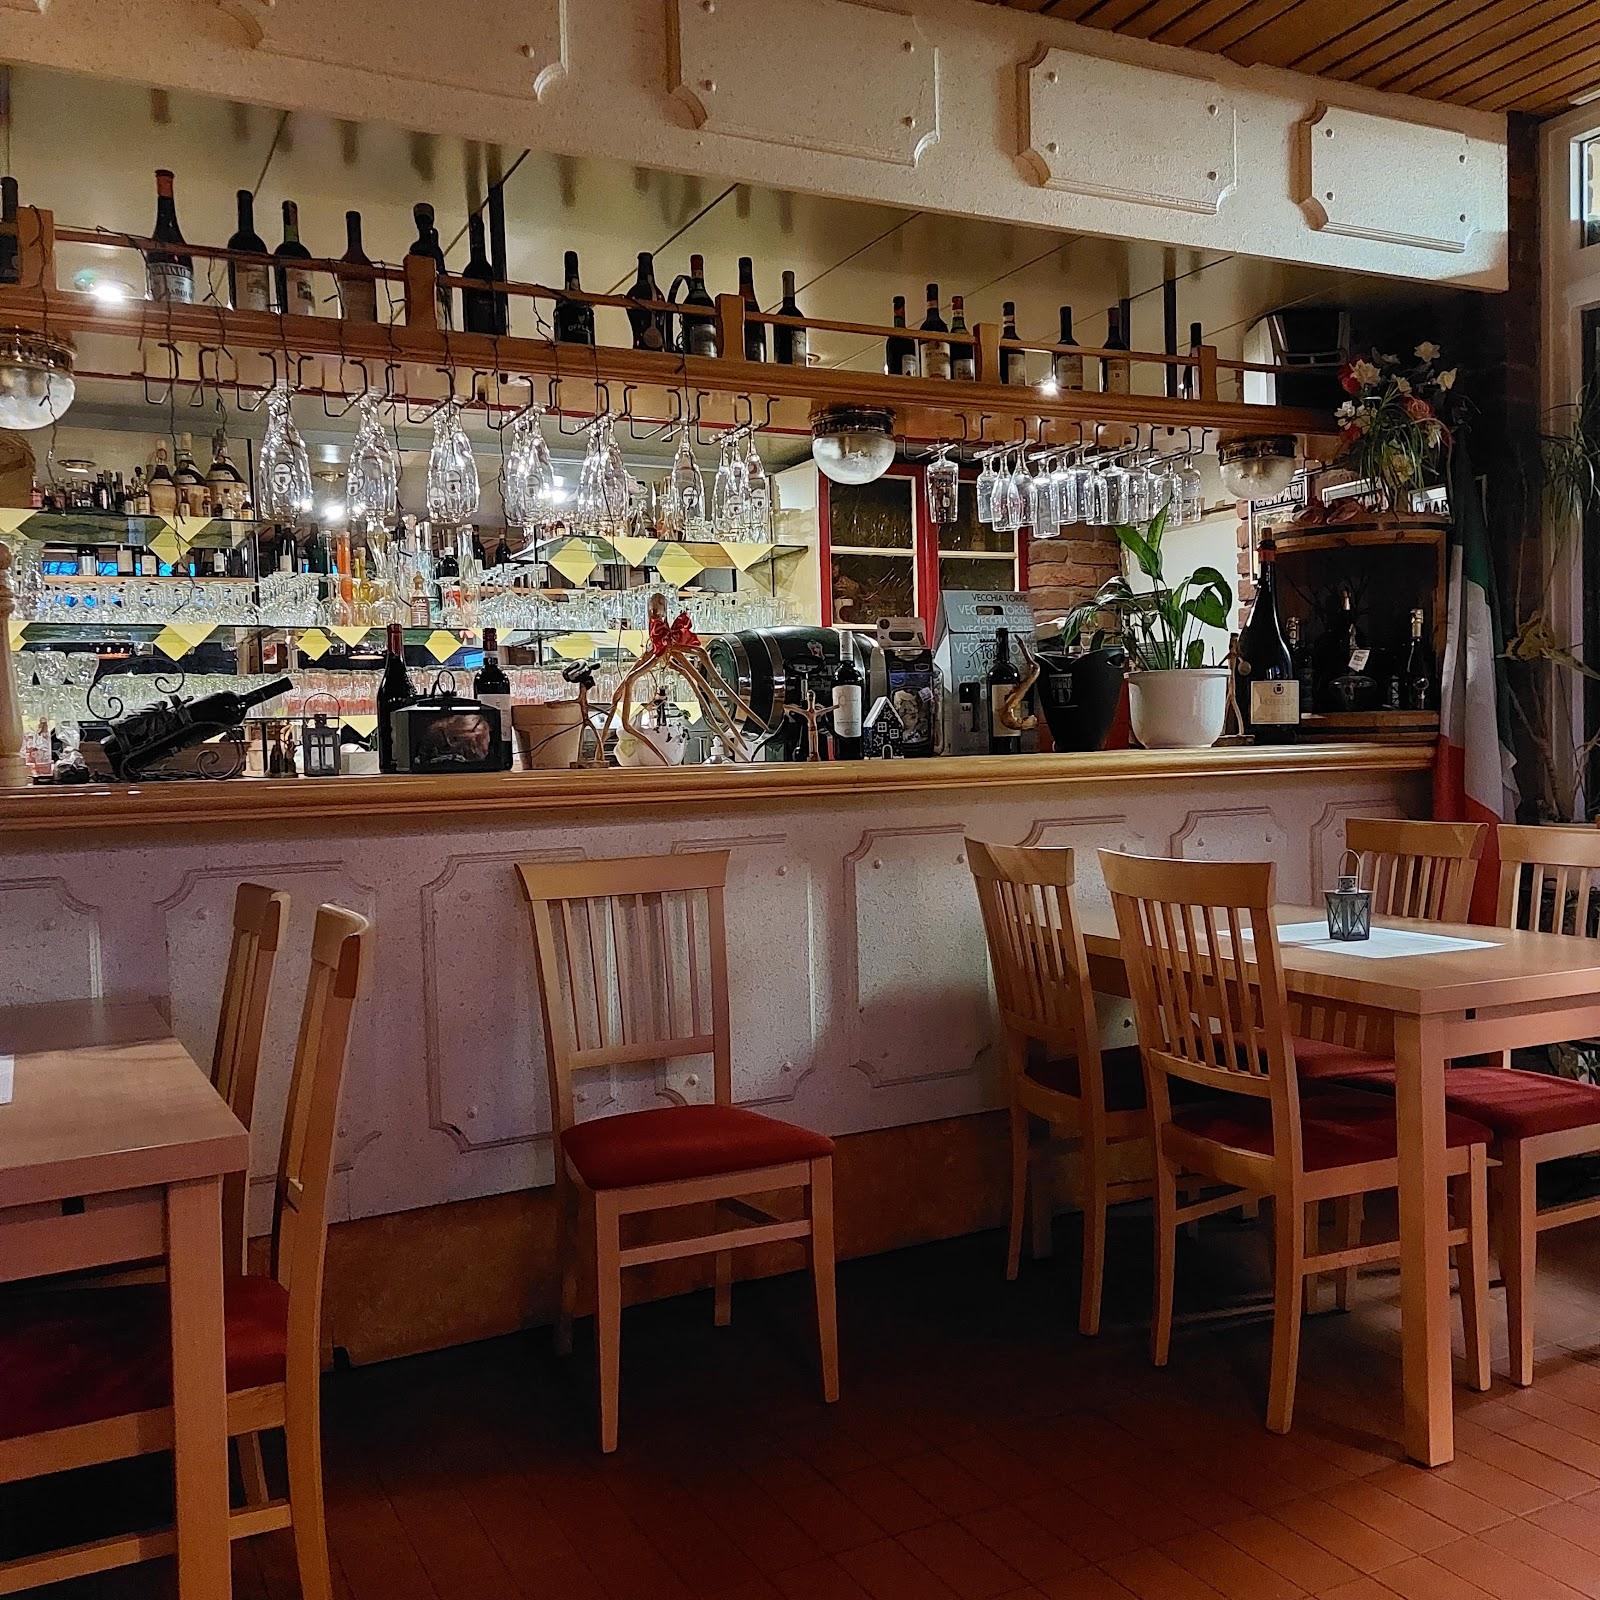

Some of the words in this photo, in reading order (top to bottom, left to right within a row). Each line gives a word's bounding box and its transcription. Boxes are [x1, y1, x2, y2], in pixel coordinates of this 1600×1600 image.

[972, 593, 1004, 603] VECCHIA
[1005, 594, 1028, 603] TORRE
[1002, 605, 1032, 616] TORRE
[976, 616, 1009, 625] VECCHIA
[1010, 617, 1033, 625] TORRE
